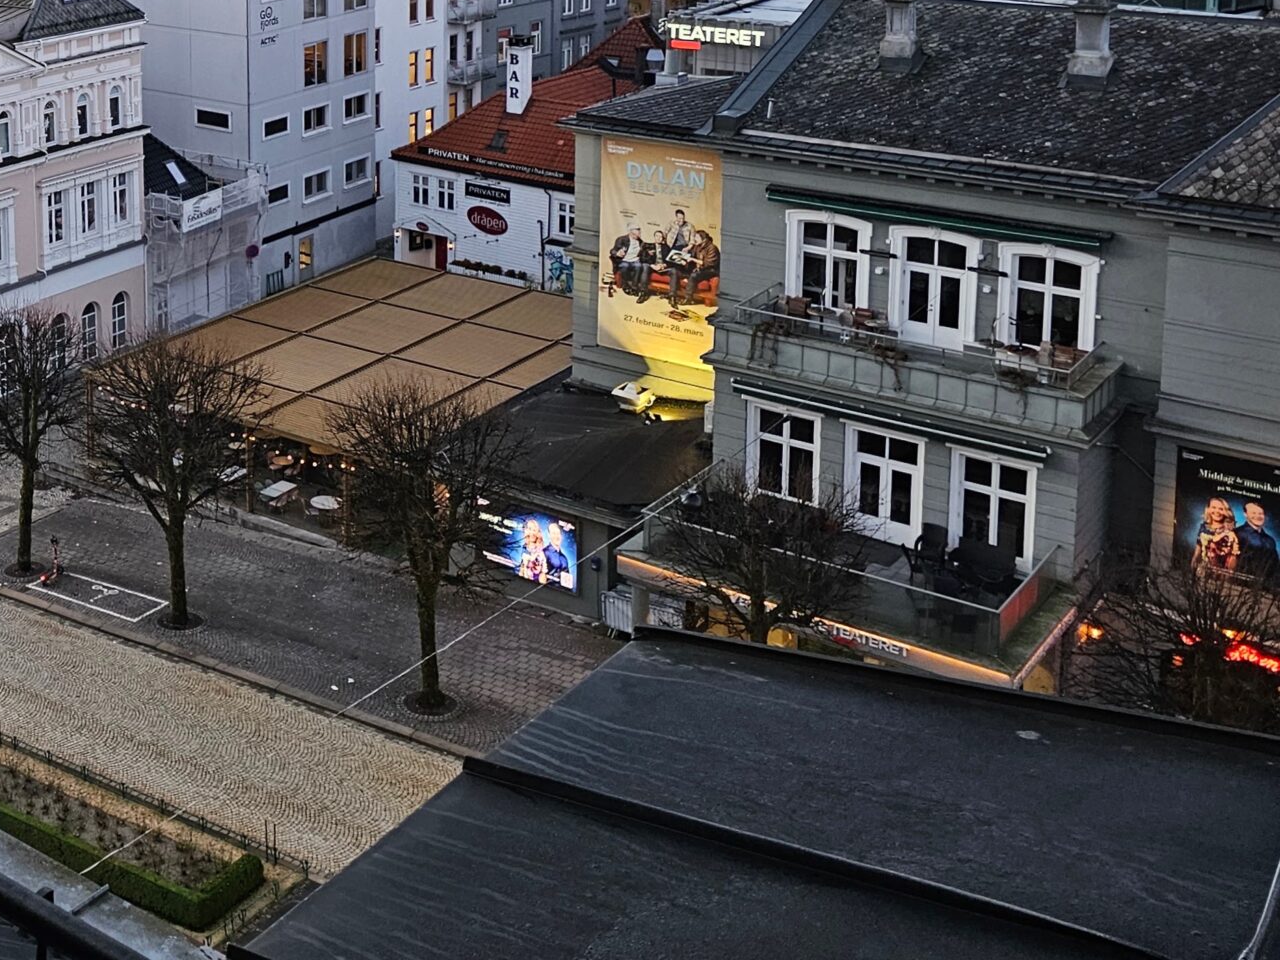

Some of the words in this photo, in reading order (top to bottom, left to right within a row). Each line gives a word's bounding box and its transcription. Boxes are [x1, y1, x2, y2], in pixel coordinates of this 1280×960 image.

[260, 6, 273, 20] GO
[667, 23, 766, 47] TEATERET
[509, 53, 520, 99] BAR
[427, 147, 470, 161] PRIVATEN
[627, 160, 705, 191] DYLAN
[468, 186, 507, 199] PRIVATEN
[471, 211, 505, 230] dråpen
[624, 314, 634, 323] 27.
[636, 317, 664, 329] februar
[670, 324, 683, 333] 28.
[684, 328, 704, 337] mars
[1200, 468, 1235, 484] Middag
[832, 623, 909, 658] TEATERET
